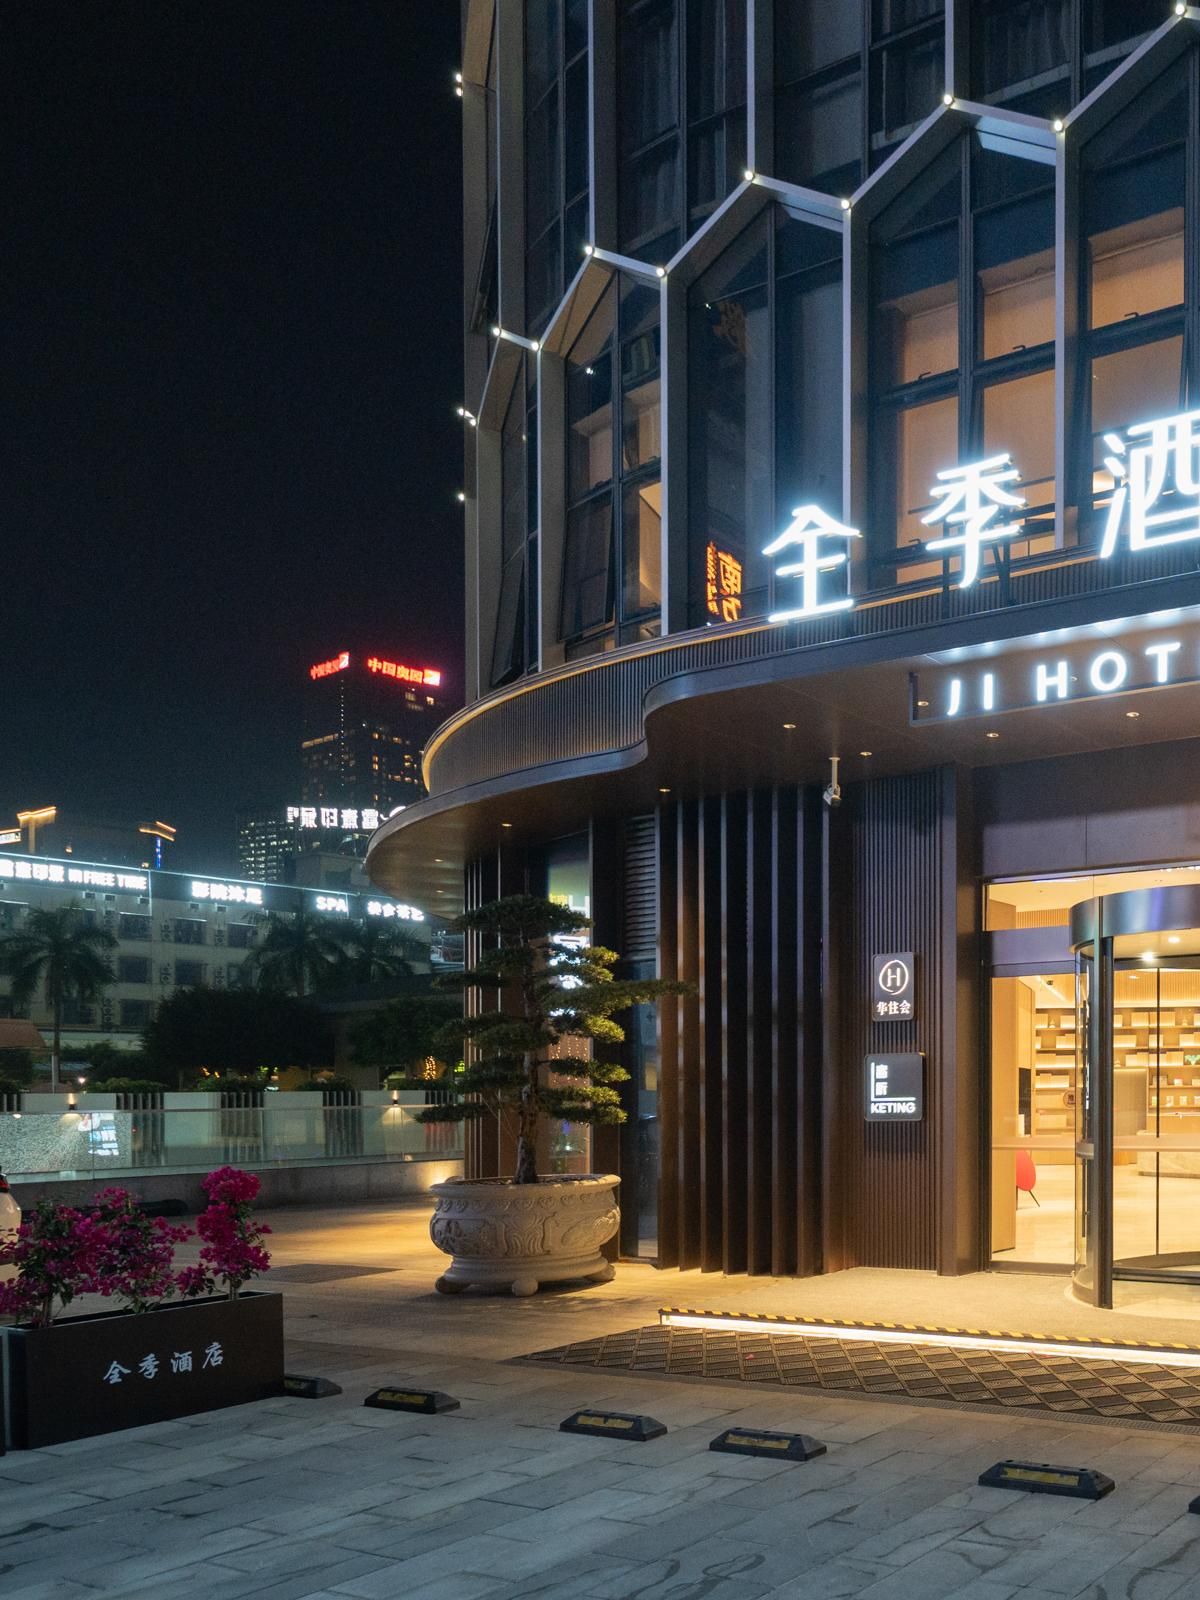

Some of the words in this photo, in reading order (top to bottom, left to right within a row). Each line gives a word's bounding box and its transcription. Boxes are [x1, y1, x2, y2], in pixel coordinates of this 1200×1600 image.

[947, 671, 993, 716] JI
[315, 895, 348, 912] SPA
[876, 999, 912, 1016] 华住会
[870, 1102, 916, 1115] KETING
[102, 1341, 225, 1385] 全季酒店
